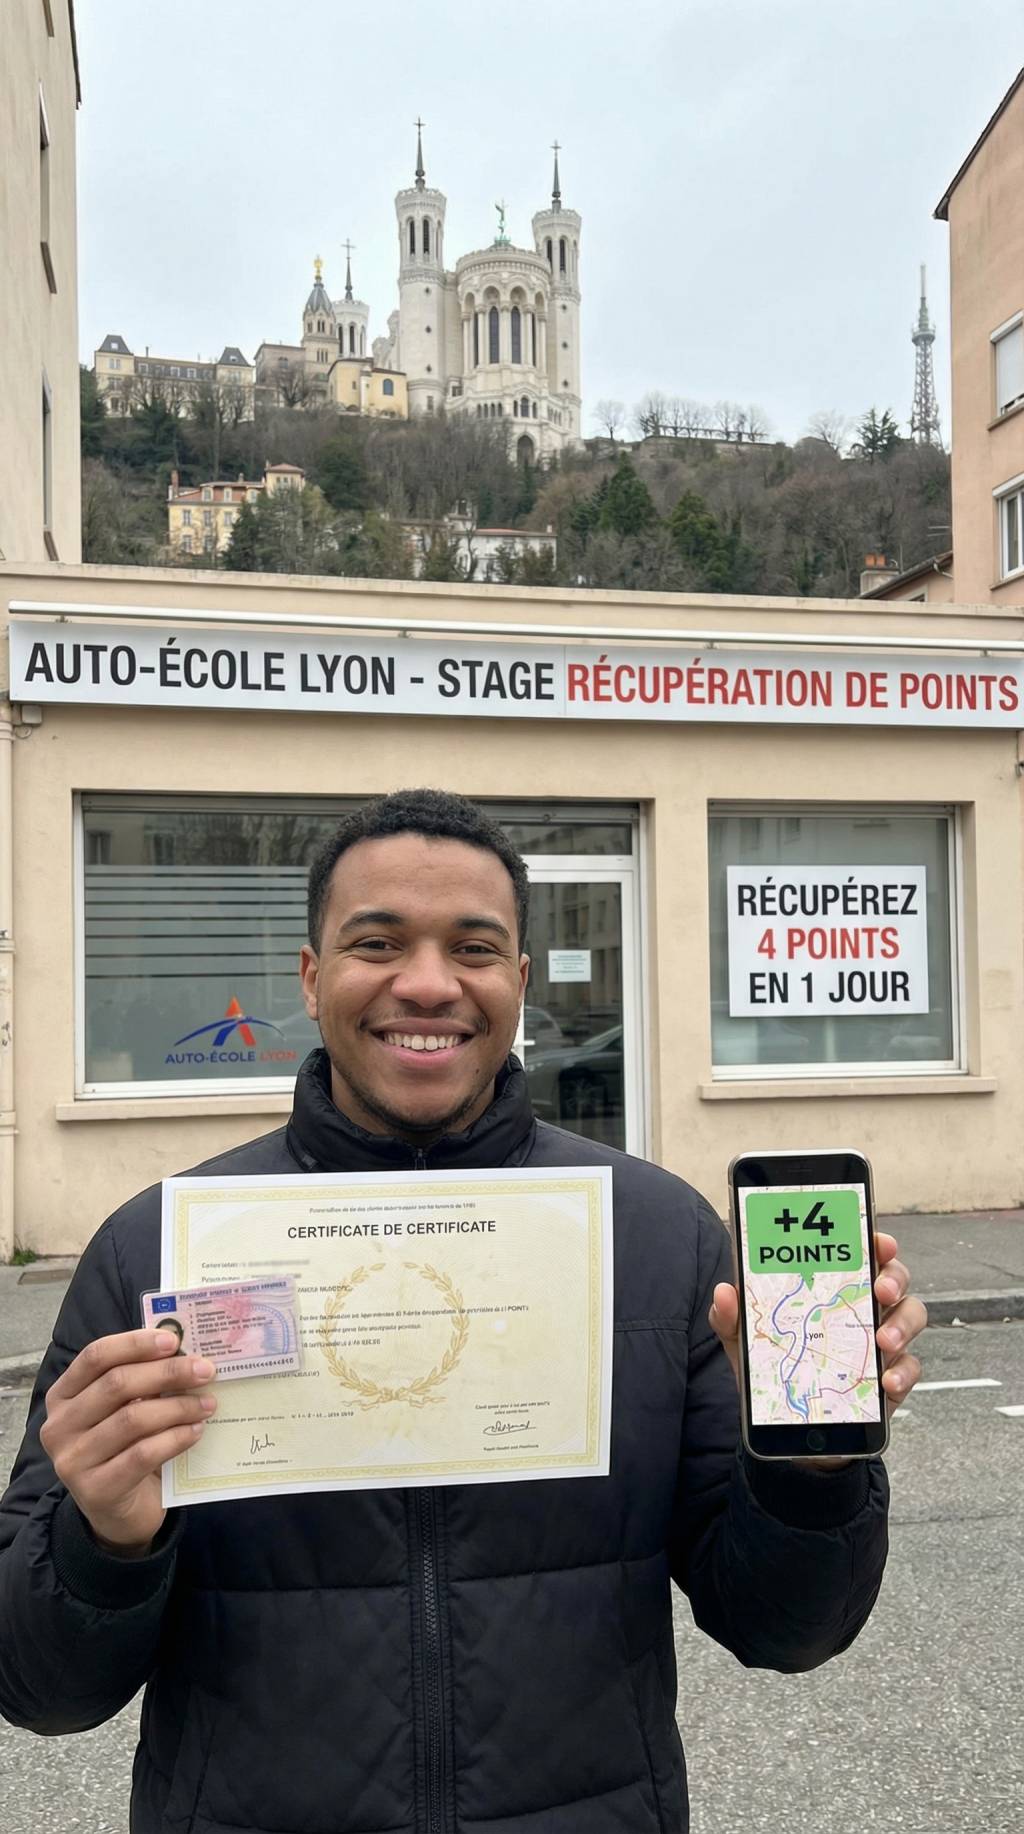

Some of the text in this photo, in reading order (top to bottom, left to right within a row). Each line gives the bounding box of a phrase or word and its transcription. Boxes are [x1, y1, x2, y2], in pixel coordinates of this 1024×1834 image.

[24, 638, 285, 691] AUTO-ÉCOLE
[300, 653, 395, 695] LYON
[438, 659, 555, 700] STAGE
[567, 655, 832, 707] RÉCUPÉRATION
[846, 671, 888, 708] DE
[900, 673, 1019, 711] POINTS
[737, 876, 918, 916] RÉCUPÉREZ
[757, 927, 900, 960] 4 POINTS
[749, 971, 910, 1003] EN 1 JOUR
[165, 1050, 256, 1064] AUTO-ÉCOLE
[287, 1220, 497, 1239] CERTIFICATE DE CERTIFICATE
[774, 1201, 835, 1236] +4
[759, 1244, 851, 1263] POINTS
